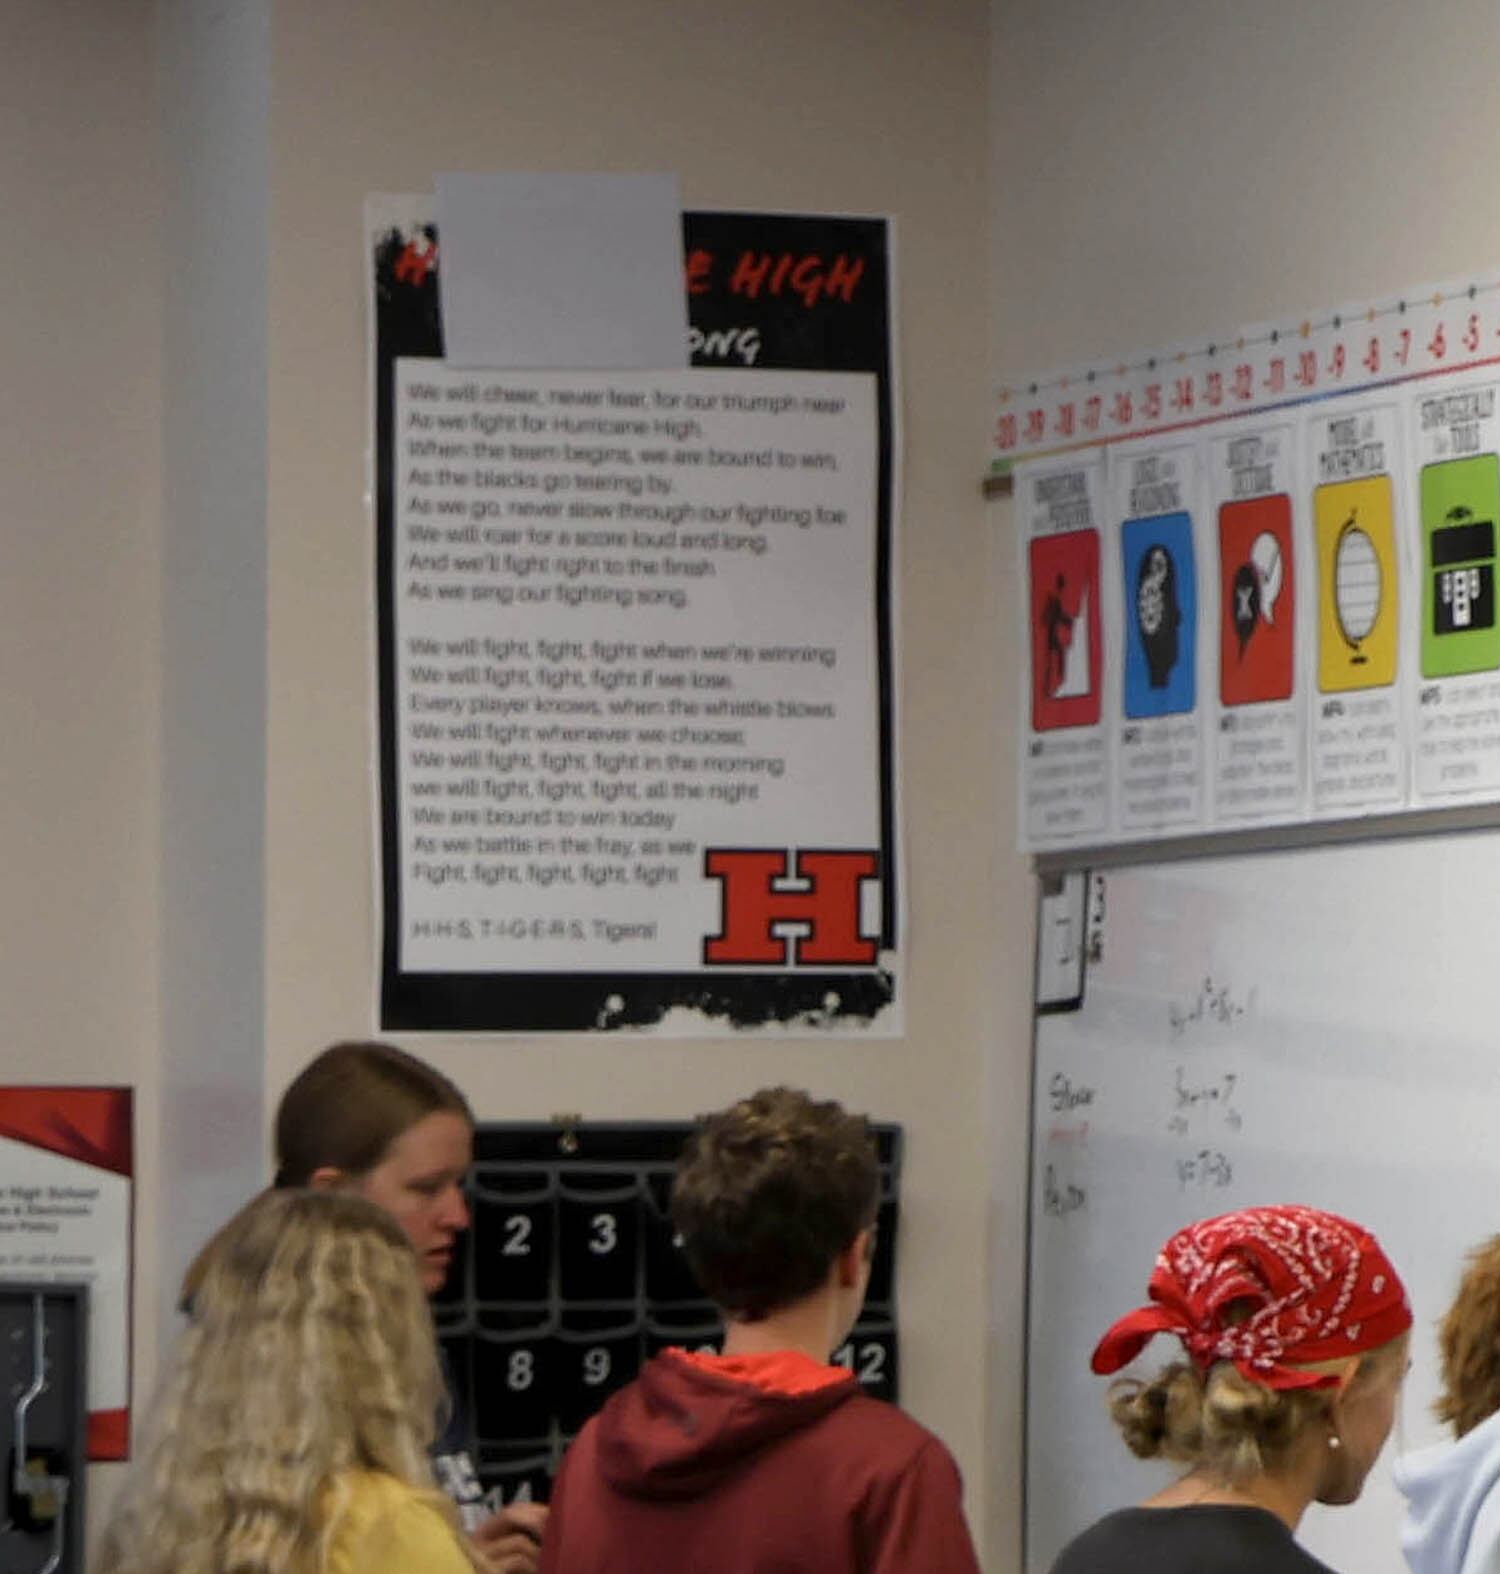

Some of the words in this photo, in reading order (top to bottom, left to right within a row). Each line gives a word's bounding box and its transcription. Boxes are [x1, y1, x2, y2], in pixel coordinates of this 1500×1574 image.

[732, 250, 864, 307] HIGH
[1293, 350, 1316, 386] -10
[1328, 344, 1344, 377] -9
[1363, 338, 1379, 372] -8
[1394, 329, 1410, 365] -7
[1428, 323, 1444, 358] -6
[1462, 315, 1478, 351] -5
[704, 848, 882, 966] H
[502, 1216, 532, 1257] 2
[588, 1214, 619, 1254] 3
[508, 1350, 535, 1390] 8
[583, 1347, 611, 1386] 9
